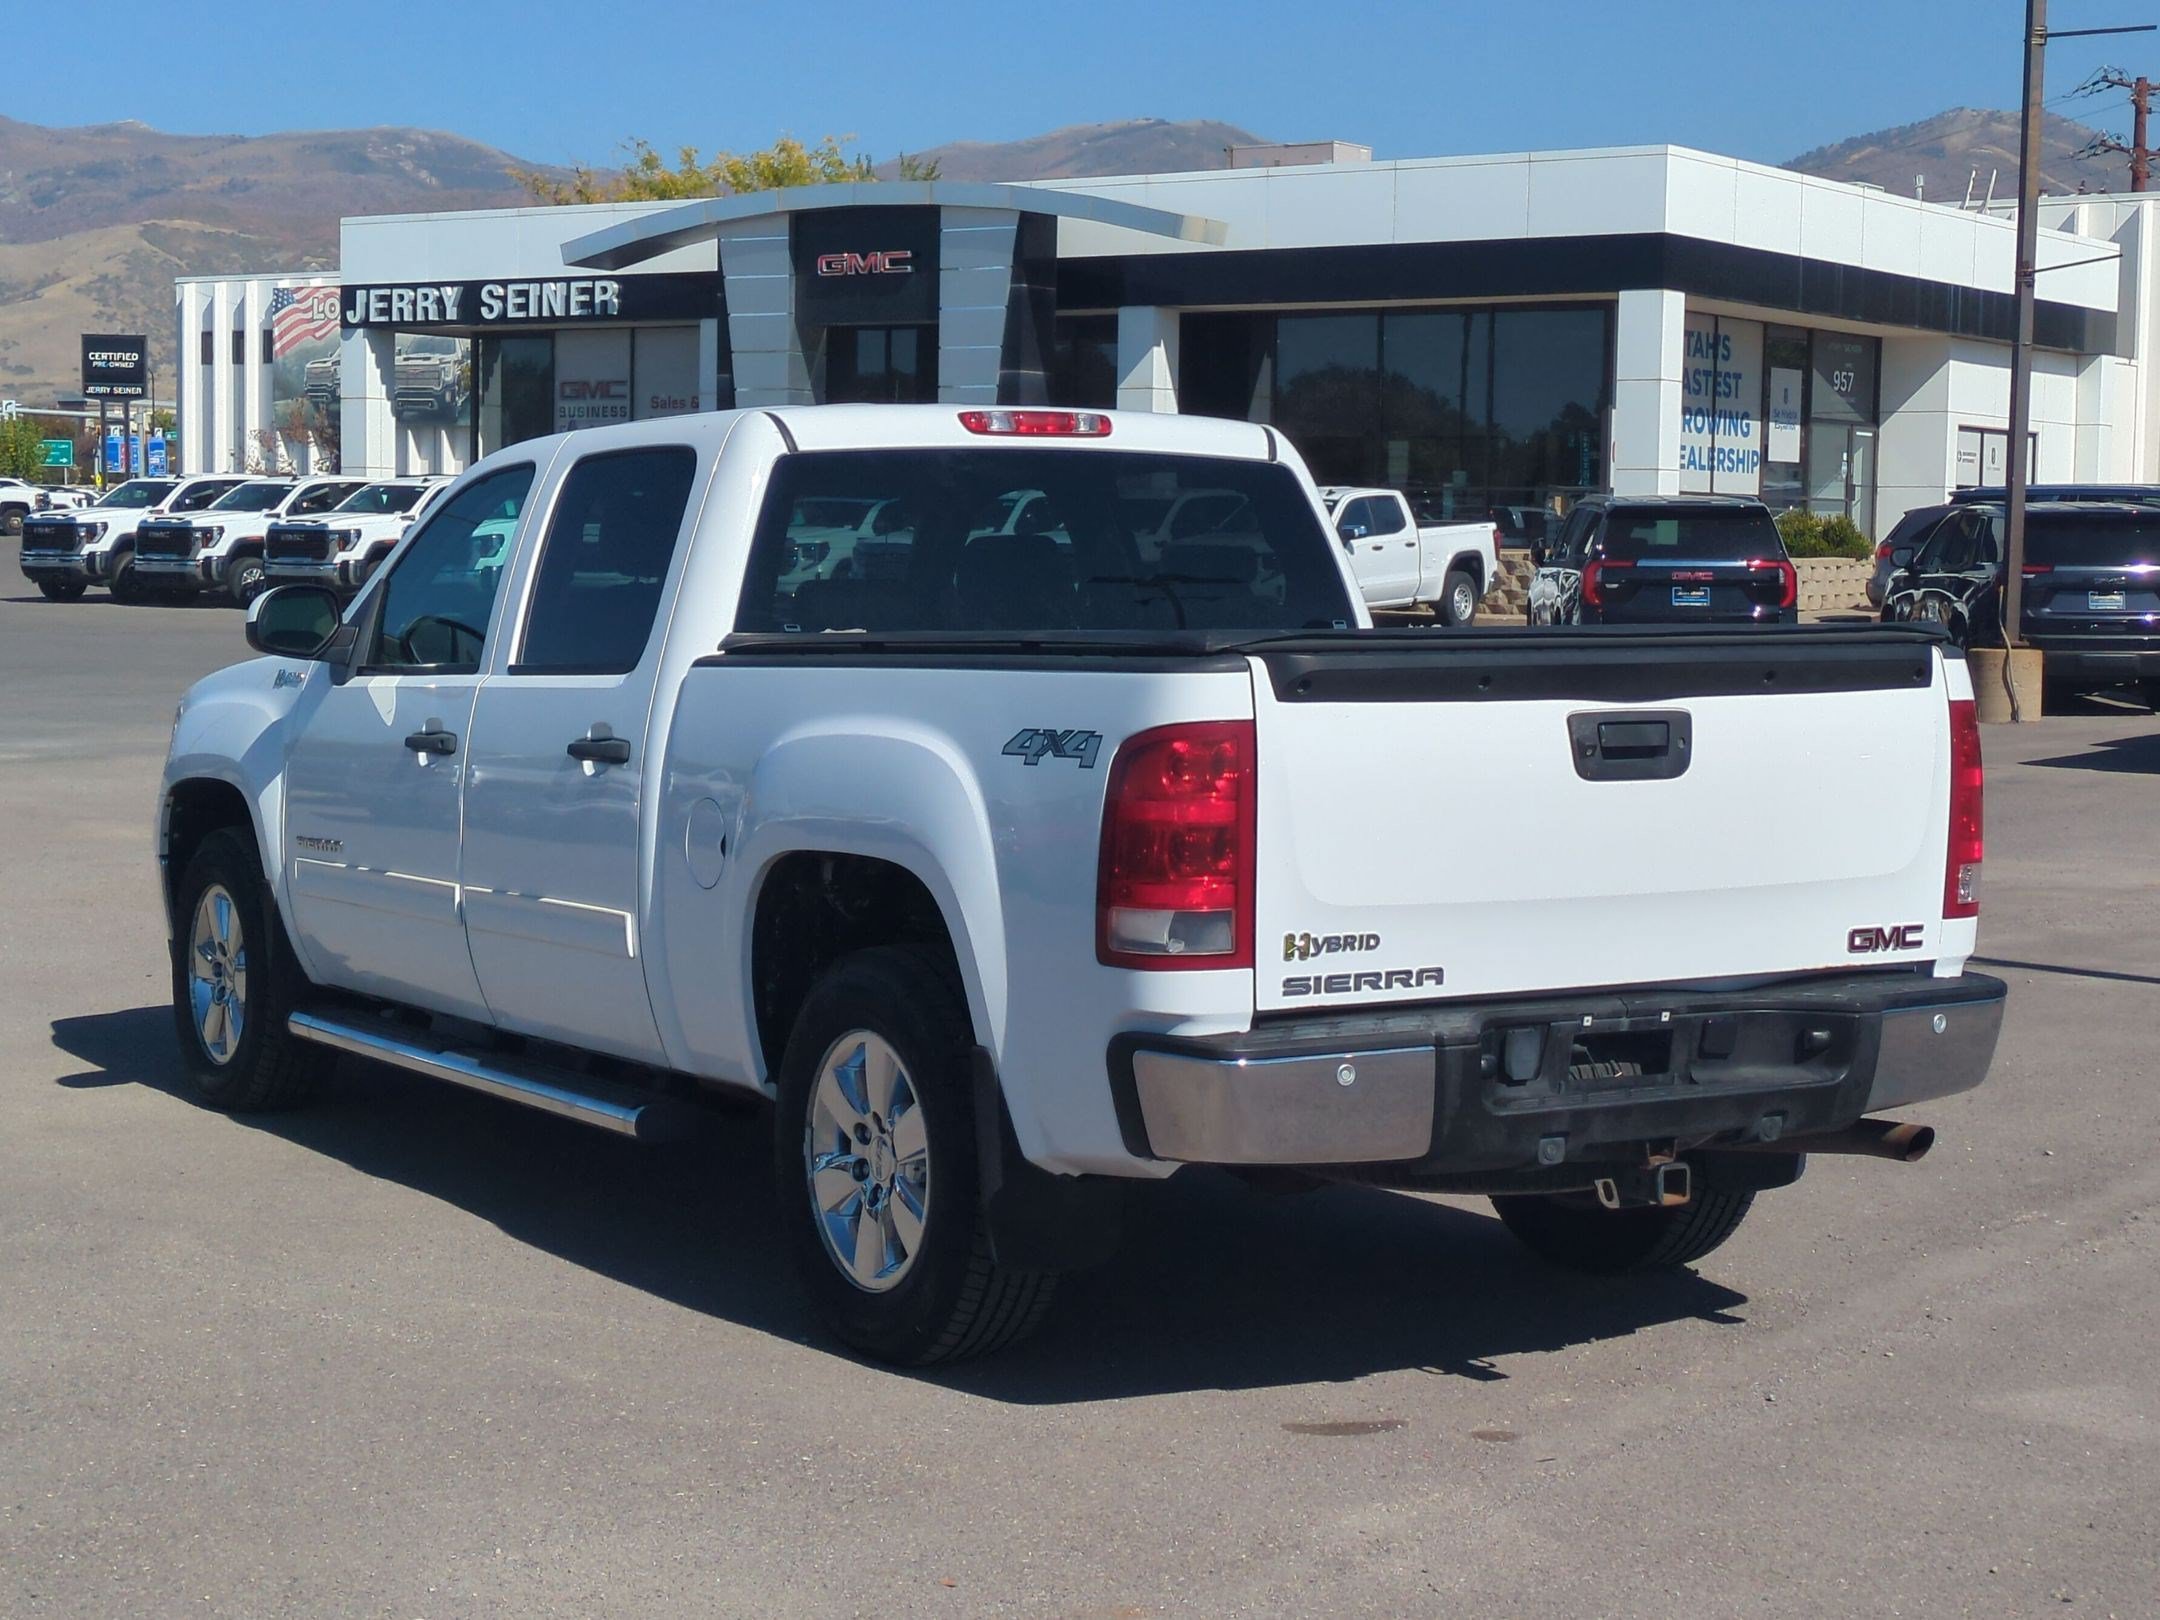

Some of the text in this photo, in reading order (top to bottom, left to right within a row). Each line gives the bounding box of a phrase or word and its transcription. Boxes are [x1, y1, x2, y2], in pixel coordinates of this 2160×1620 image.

[817, 251, 912, 276] GMC
[346, 280, 620, 324] JERRY SEINER
[88, 352, 139, 361] CERTIFIED
[85, 386, 142, 394] JERRY SEINER
[560, 379, 627, 399] GMC
[1833, 371, 1854, 392] 957
[559, 406, 627, 418] BUSINESS
[651, 396, 686, 410] Sales
[1847, 924, 1924, 953] GMC
[1282, 966, 1444, 997] SIERRA
